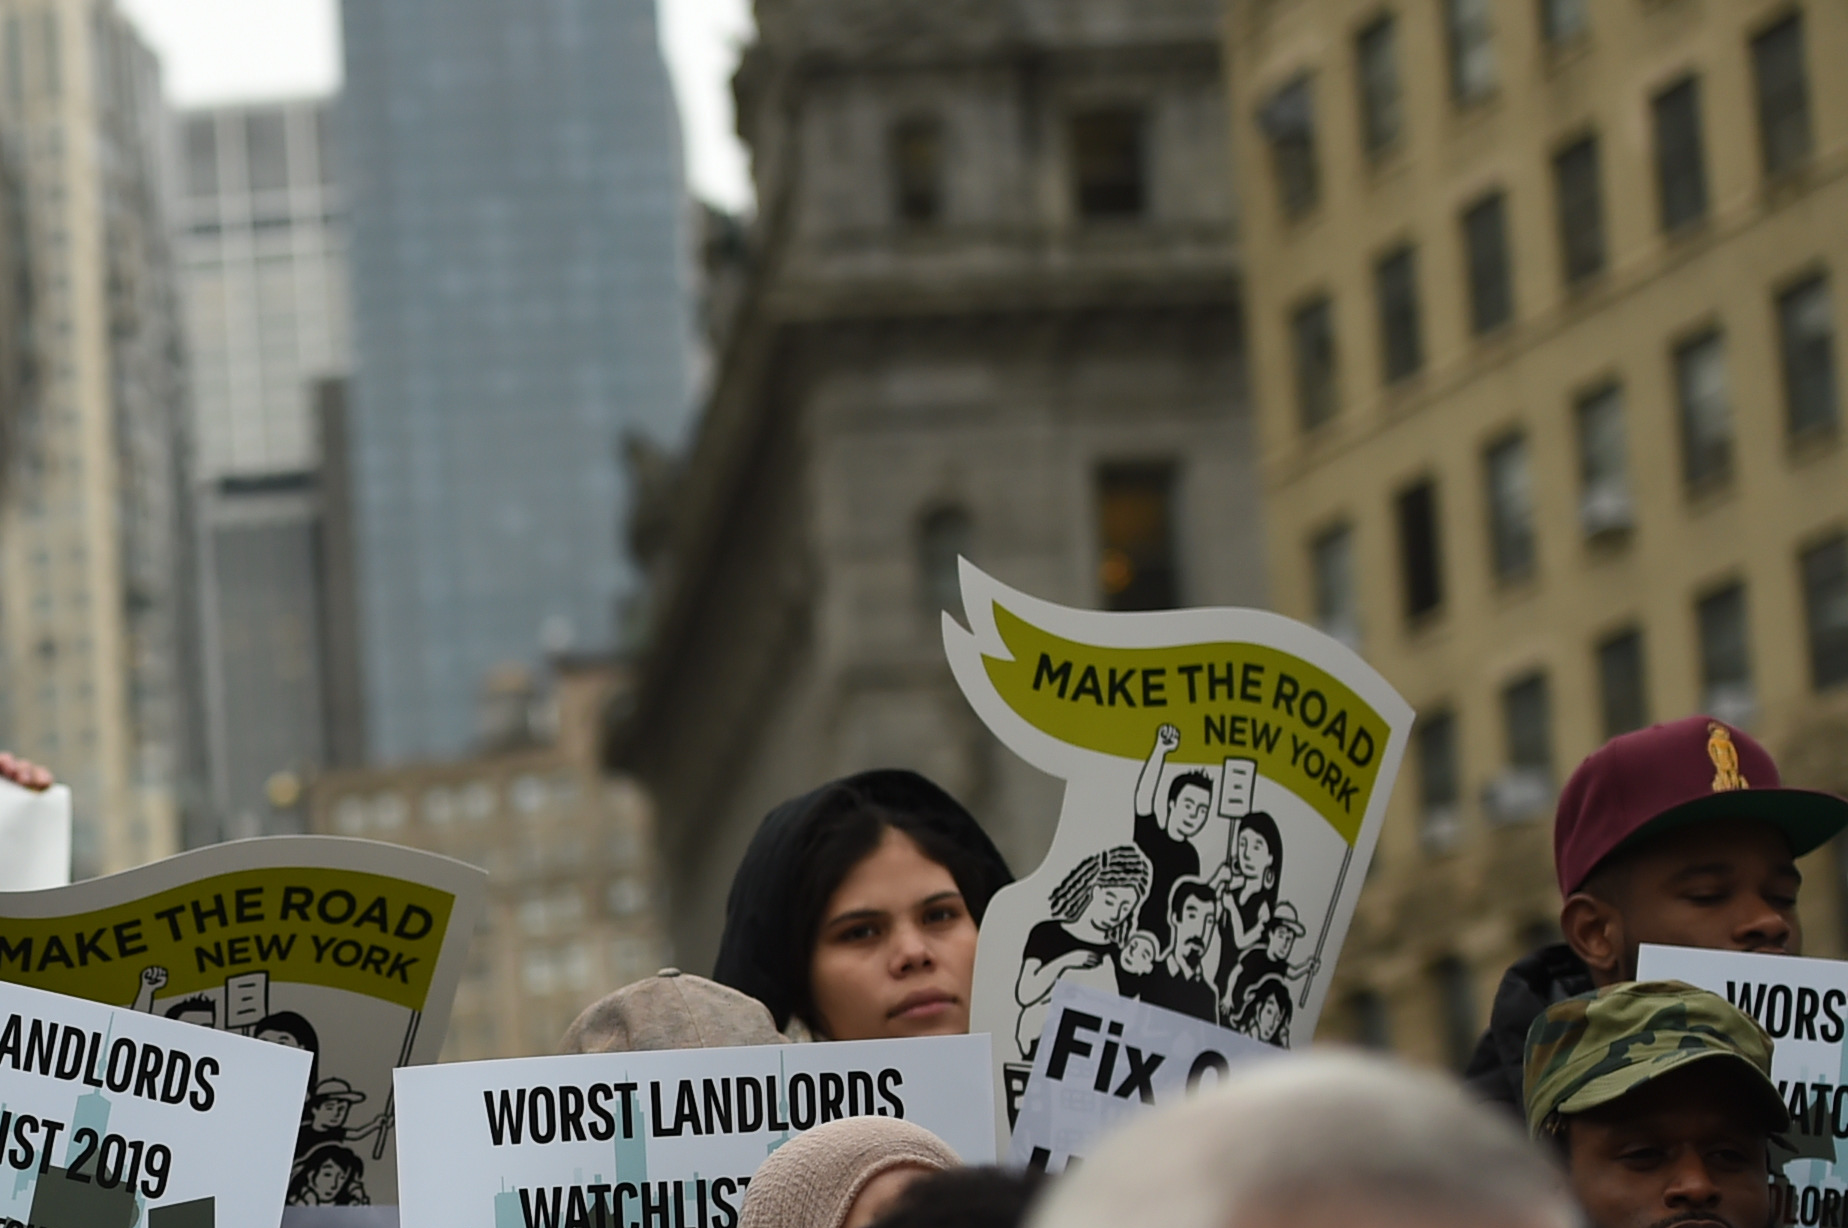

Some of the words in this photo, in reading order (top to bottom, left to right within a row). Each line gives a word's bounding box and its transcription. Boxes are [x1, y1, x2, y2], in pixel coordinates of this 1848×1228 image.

[1032, 652, 1167, 707] MAKE
[1178, 661, 1264, 704] THE
[1273, 671, 1375, 769] ROAD
[1203, 715, 1282, 753] NEW
[1291, 734, 1359, 814] YORK
[155, 886, 265, 941] THE
[279, 885, 433, 941] ROAD
[194, 933, 297, 973] NEW
[310, 934, 420, 984] YORK
[1045, 1006, 1164, 1105] Fix
[484, 1081, 638, 1147] WORST
[650, 1068, 904, 1138] LANDLORDS
[66, 1127, 171, 1199] 2019
